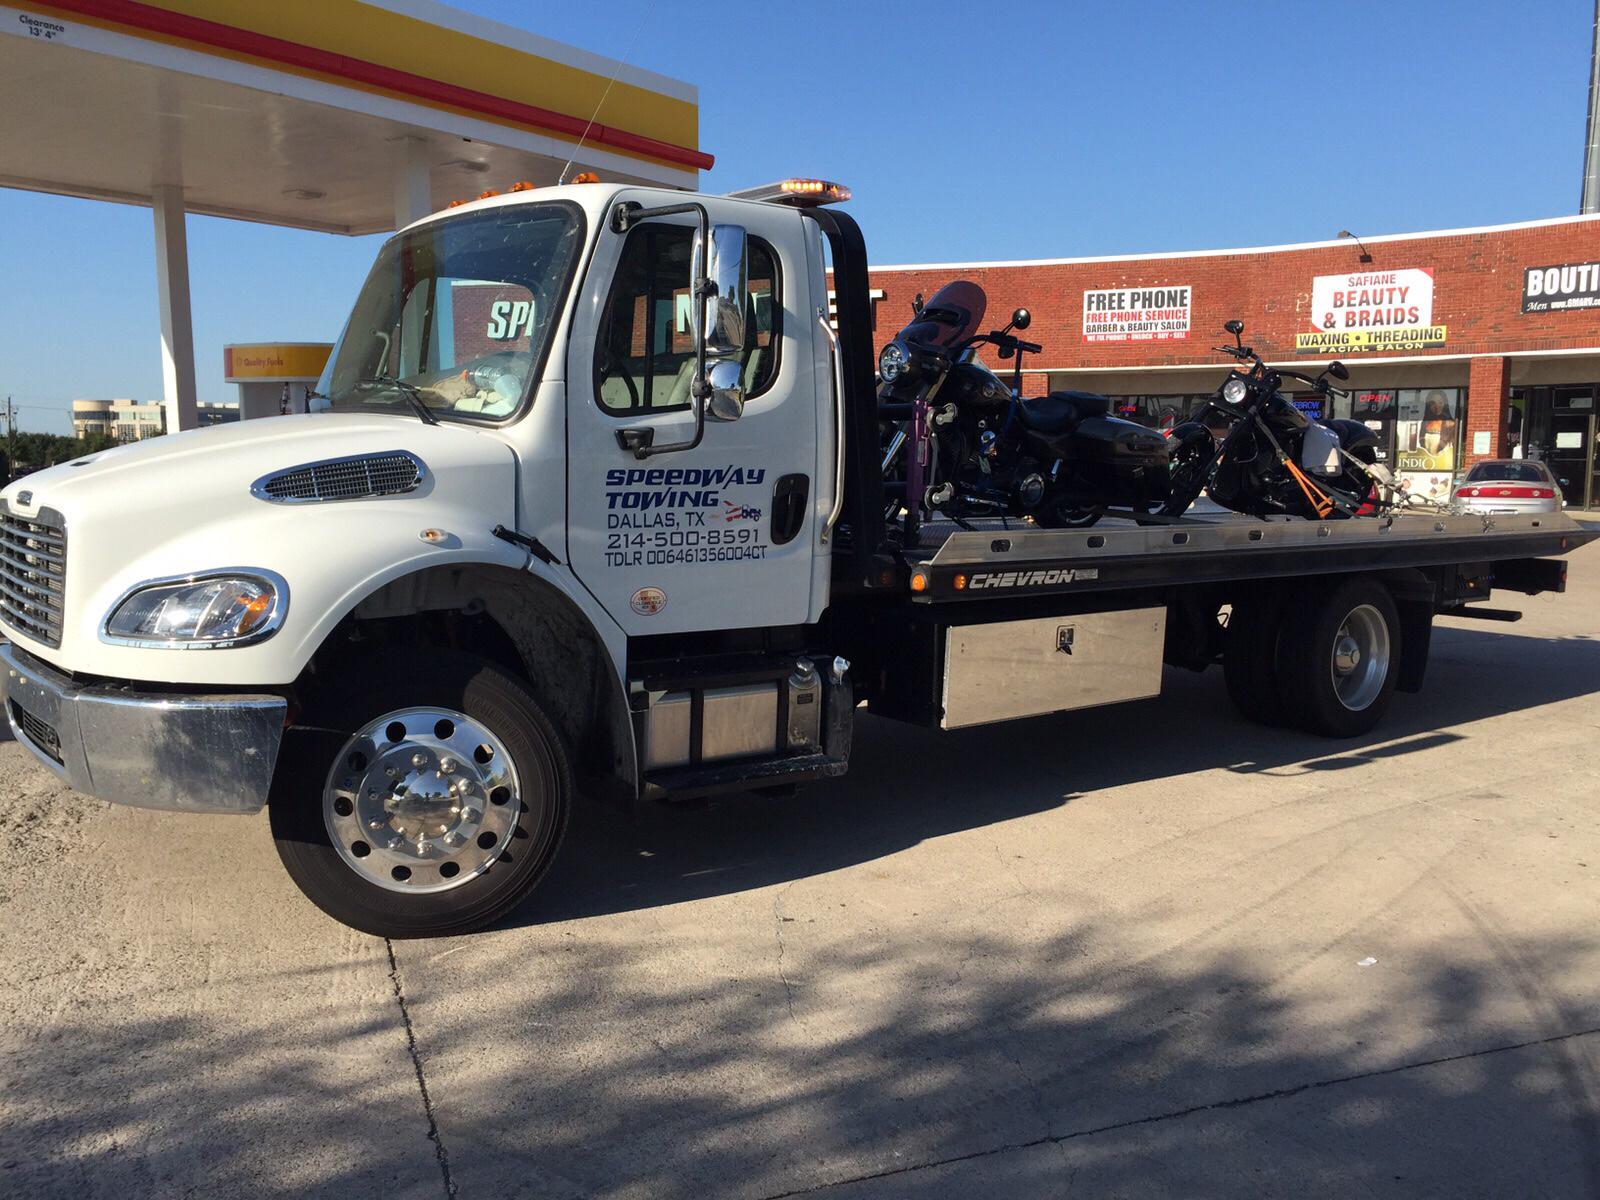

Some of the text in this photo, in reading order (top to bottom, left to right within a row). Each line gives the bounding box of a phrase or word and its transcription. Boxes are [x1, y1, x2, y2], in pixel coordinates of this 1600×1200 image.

[19, 14, 65, 32] Clearance
[28, 26, 42, 37] 13'
[1348, 274, 1397, 288] SAFIANE
[1087, 289, 1188, 311] FREE PHONE
[1333, 286, 1410, 308] BEAUTY
[1086, 309, 1187, 323] FREE PHONE SERVICE
[1323, 306, 1420, 329] & BRAIDS
[1086, 320, 1187, 333] BARBER & BEAUTY SALON
[1299, 328, 1443, 346] WAXING THREADING
[1319, 342, 1424, 354] FACIAL SALON
[1360, 394, 1392, 403] OPEN
[605, 487, 720, 511] TOWING
[608, 511, 705, 530] DALLAS, TX
[607, 529, 759, 549] 214-500-8591
[605, 551, 642, 567] TDLR
[969, 569, 1075, 589] CHEVRON
